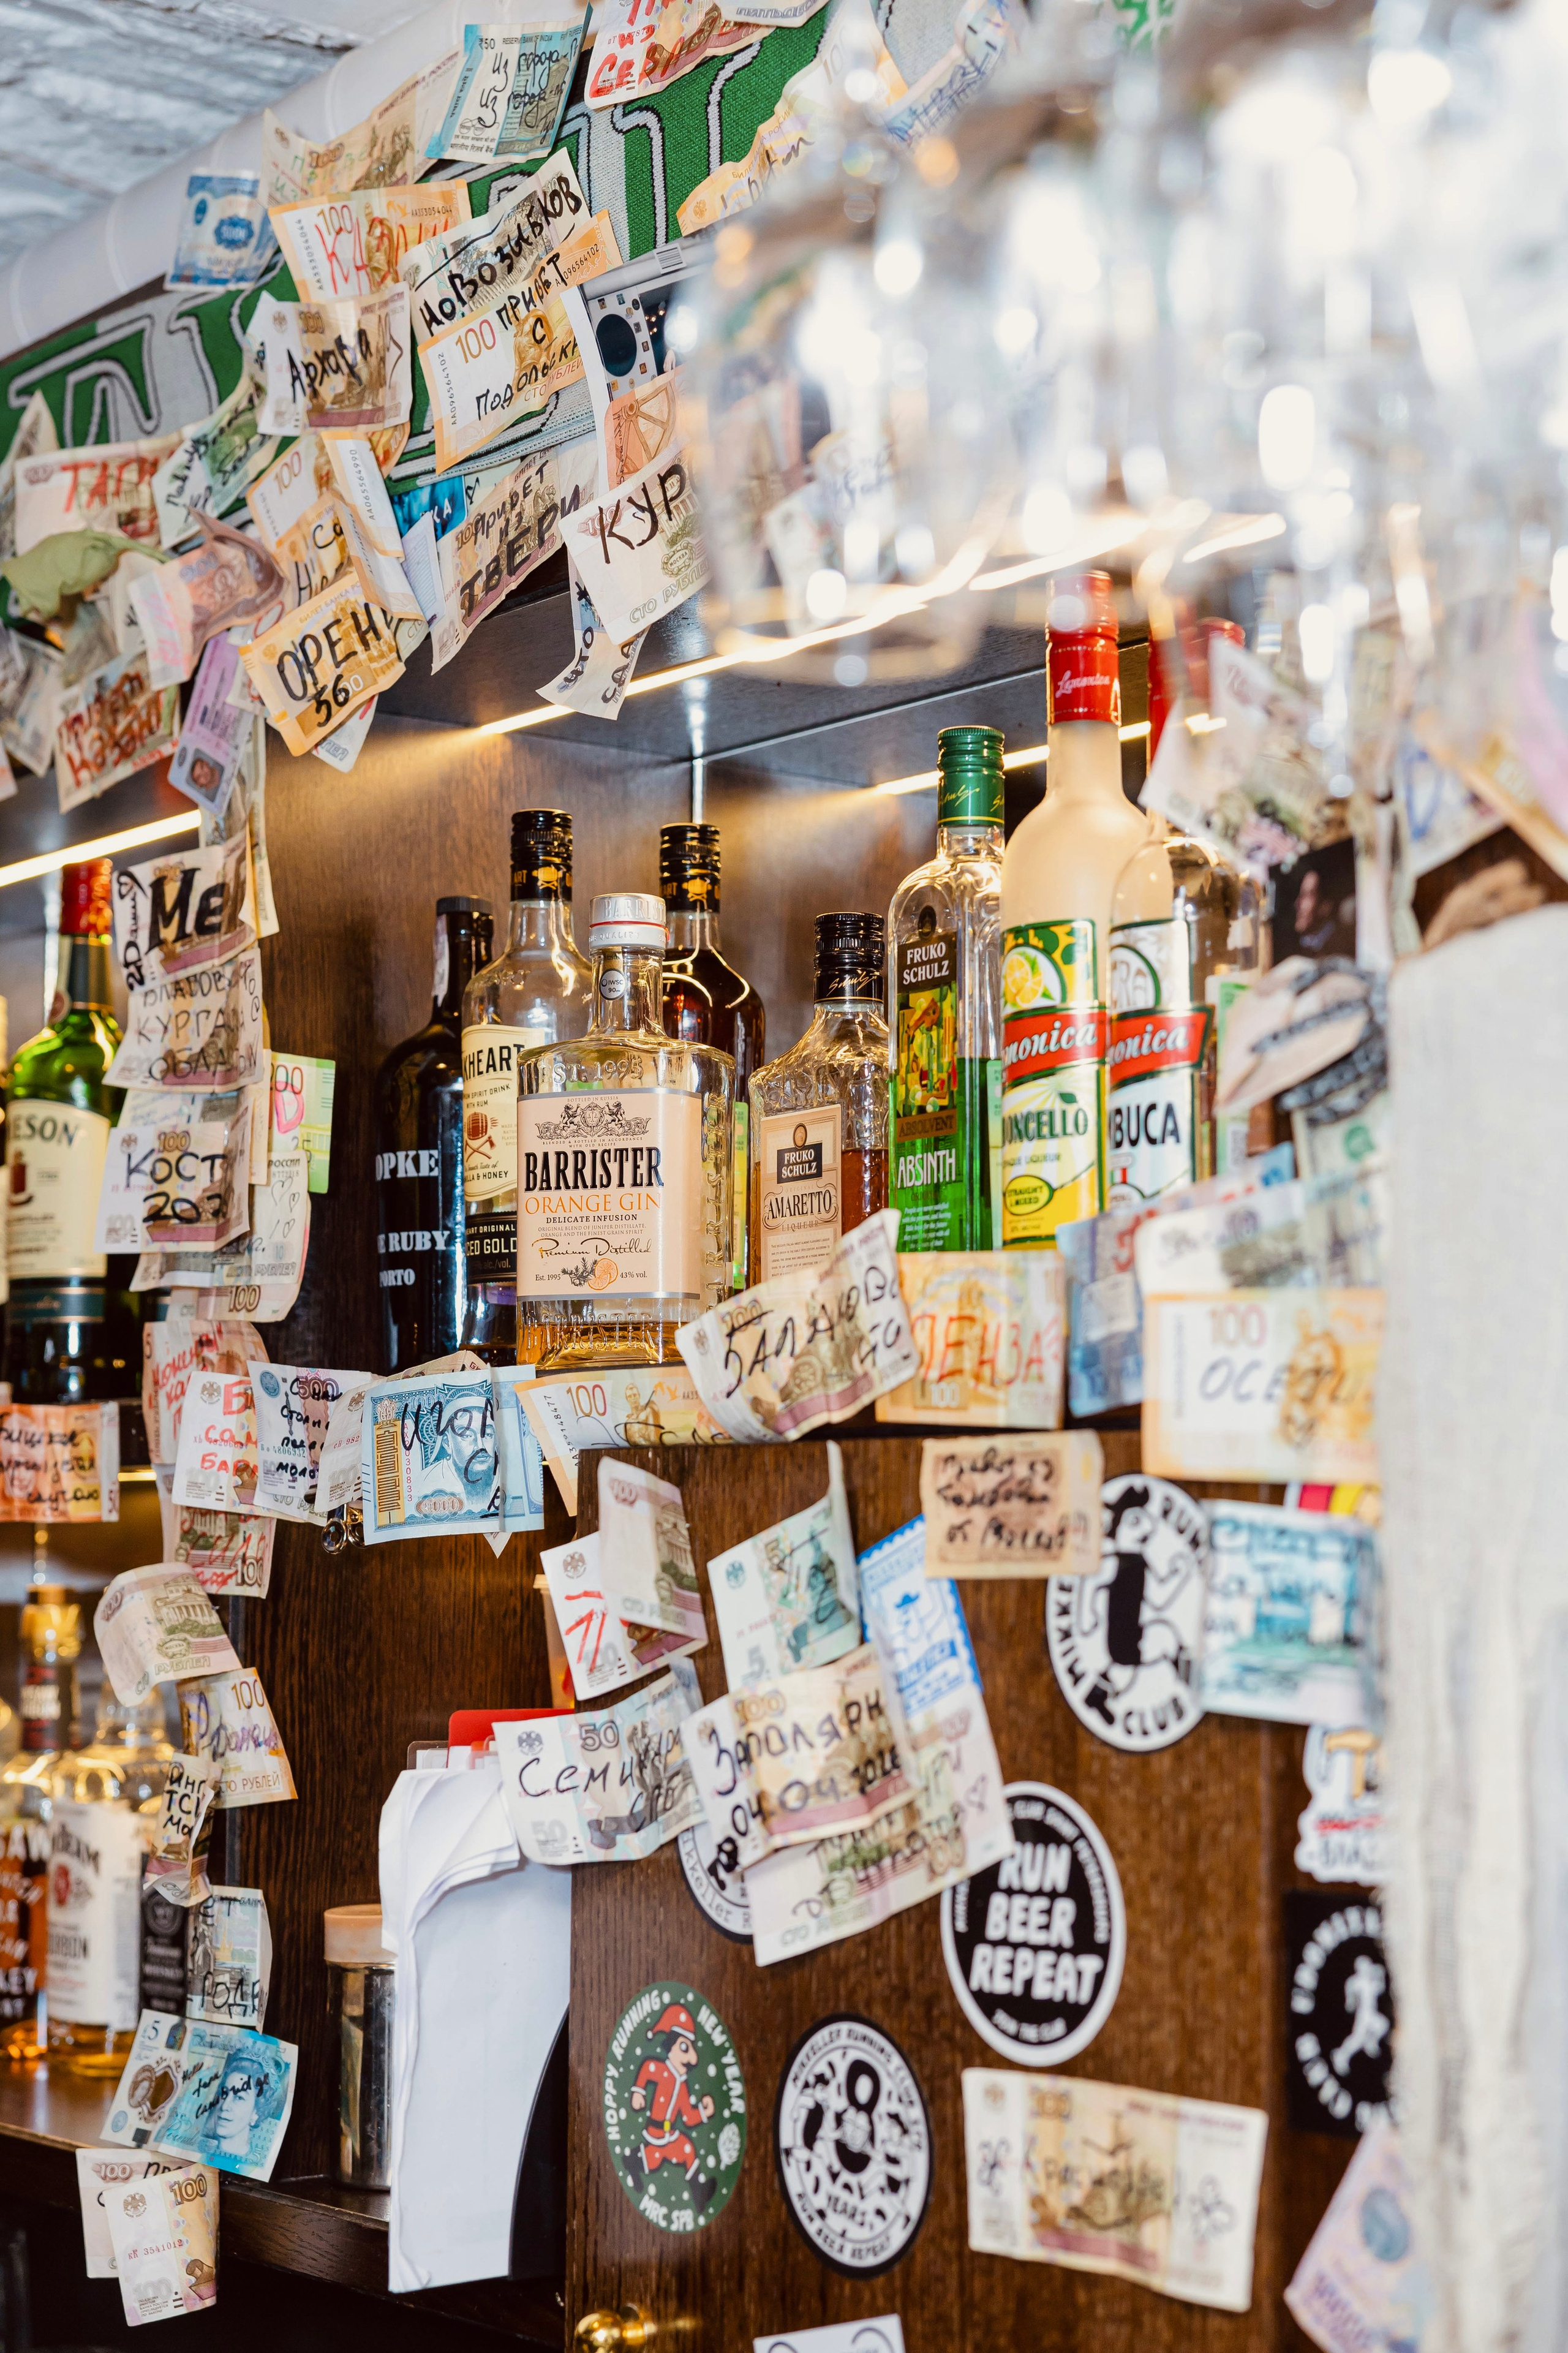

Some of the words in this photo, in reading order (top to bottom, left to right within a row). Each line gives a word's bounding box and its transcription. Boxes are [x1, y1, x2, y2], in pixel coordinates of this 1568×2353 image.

[455, 319, 497, 364] 100
[524, 383, 547, 402] СТО
[273, 451, 302, 494] 100
[629, 597, 658, 625] СТО
[907, 942, 946, 966] FRUKO
[903, 960, 950, 986] SCHULZ
[490, 1084, 510, 1095] DRINK
[524, 1146, 665, 1193] BARRISTER
[782, 1161, 818, 1179] SCHULZ
[784, 1149, 815, 1165] FRUKO
[897, 1147, 956, 1189] ABSINTH
[482, 1170, 509, 1180] HONEY
[525, 1194, 612, 1215] ORANGE
[619, 1192, 661, 1211] GIN
[767, 1189, 832, 1220] AMARETTO
[479, 1223, 516, 1234] ORIGINAL
[546, 1215, 591, 1224] DELICATE
[593, 1214, 638, 1223] INFUSION
[782, 1220, 820, 1232] LIQUEUR
[388, 1230, 450, 1253] RUBY
[531, 1237, 589, 1259] Premium
[581, 1237, 652, 1256] Distilled
[535, 1273, 546, 1282] Est.
[228, 1285, 262, 1313] 100
[1208, 1303, 1267, 1346] 100
[566, 1384, 607, 1417] 100
[930, 1382, 960, 1407] 100
[231, 1679, 265, 1711] 100
[1122, 1696, 1184, 1737] CLUB
[579, 1720, 620, 1752] 50
[242, 1770, 281, 1792] РУБЛЕЙ
[997, 1840, 1072, 1894] RUN
[984, 1891, 1077, 1949] BEER
[968, 1943, 1104, 2006] REPEAT
[611, 1989, 662, 2062] RUNNING
[696, 2004, 728, 2047] NEW
[720, 2048, 746, 2115] YEAR
[604, 2063, 621, 2142] HOPPY
[99, 2163, 132, 2181] 100
[170, 2173, 208, 2207] 100
[639, 2193, 668, 2228] MRC
[670, 2208, 695, 2232] SPB
[143, 2238, 184, 2256] 3541012
